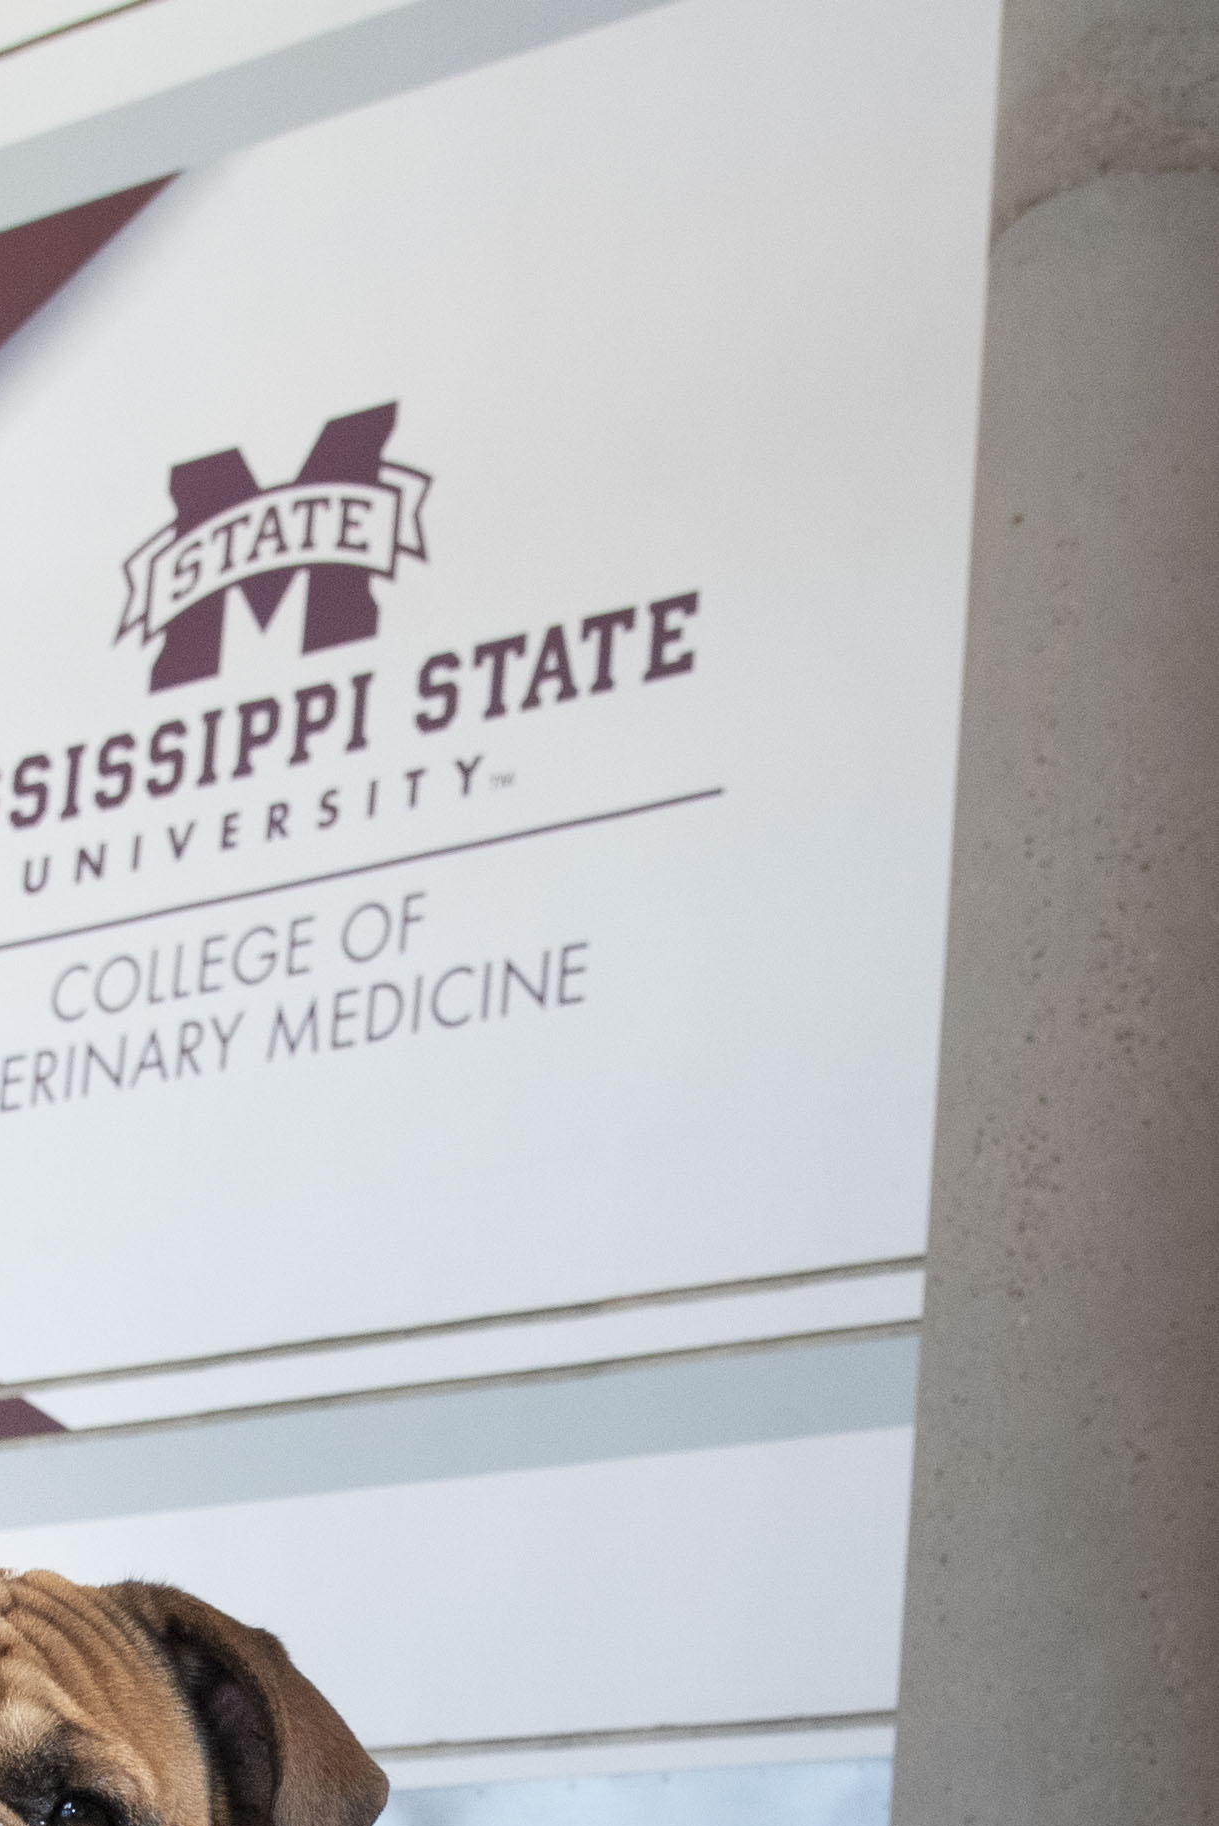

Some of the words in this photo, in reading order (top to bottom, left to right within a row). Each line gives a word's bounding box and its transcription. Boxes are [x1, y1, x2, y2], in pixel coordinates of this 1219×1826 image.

[168, 493, 375, 604] STATE
[412, 588, 703, 737] STATE
[21, 753, 485, 897] UNIVERSITY
[50, 914, 316, 1023] COLLEGE
[339, 890, 427, 964] OF
[266, 941, 590, 1062] MEDICINE
